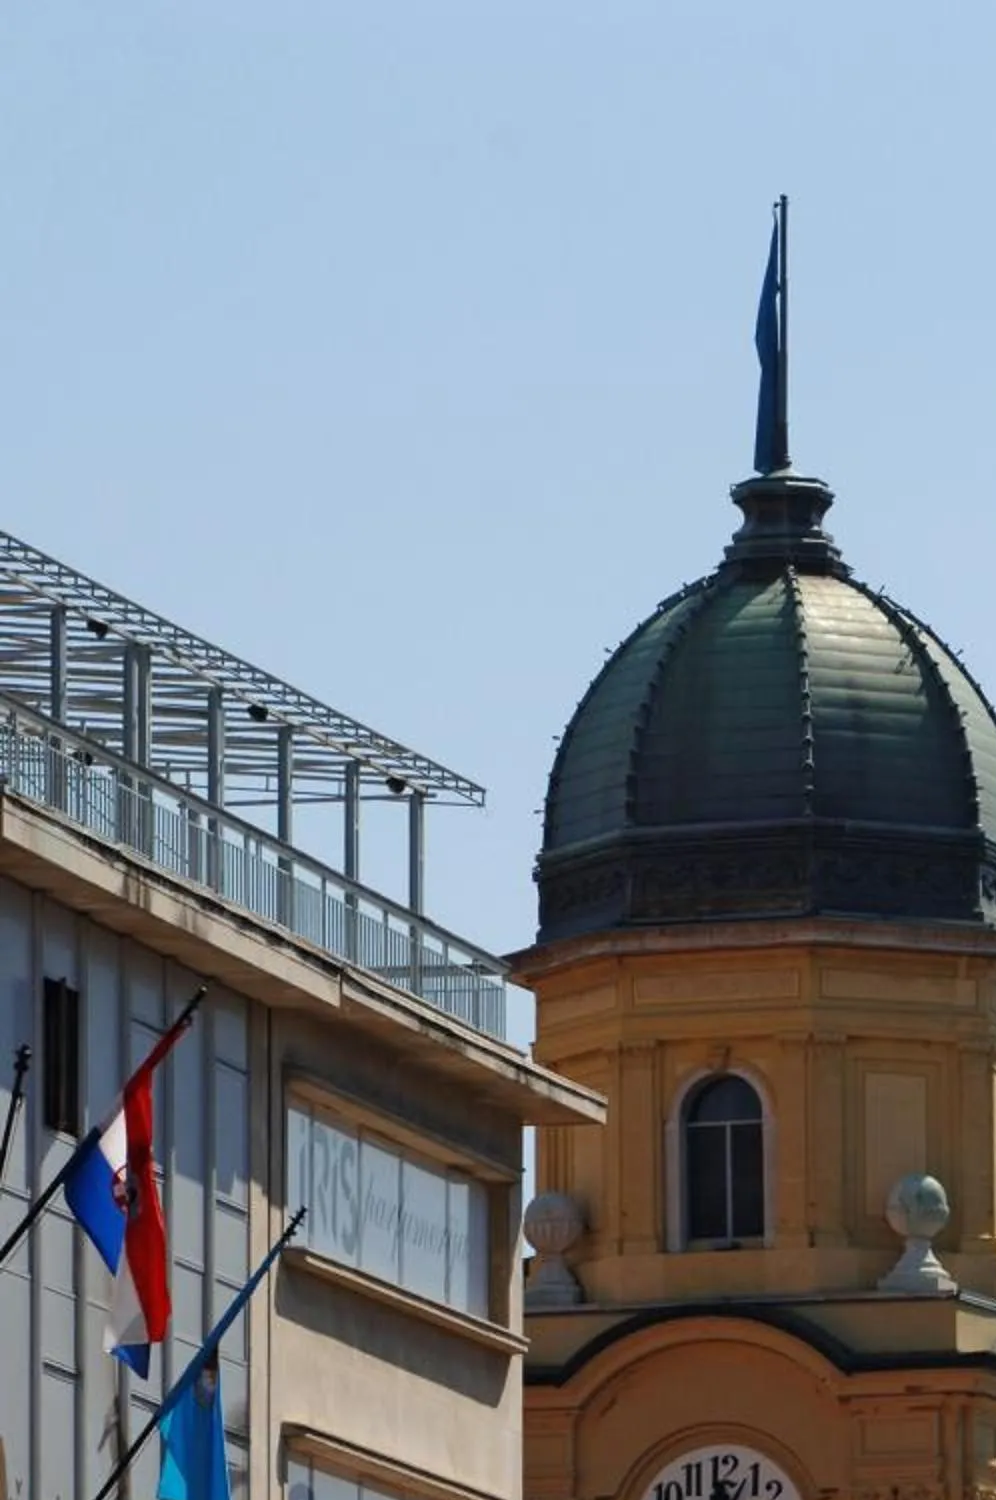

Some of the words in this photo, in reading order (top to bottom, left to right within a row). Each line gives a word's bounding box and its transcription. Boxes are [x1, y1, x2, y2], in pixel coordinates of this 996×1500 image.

[681, 1461, 703, 1497] 11
[710, 1454, 739, 1489] 12
[749, 1461, 760, 1497] 1
